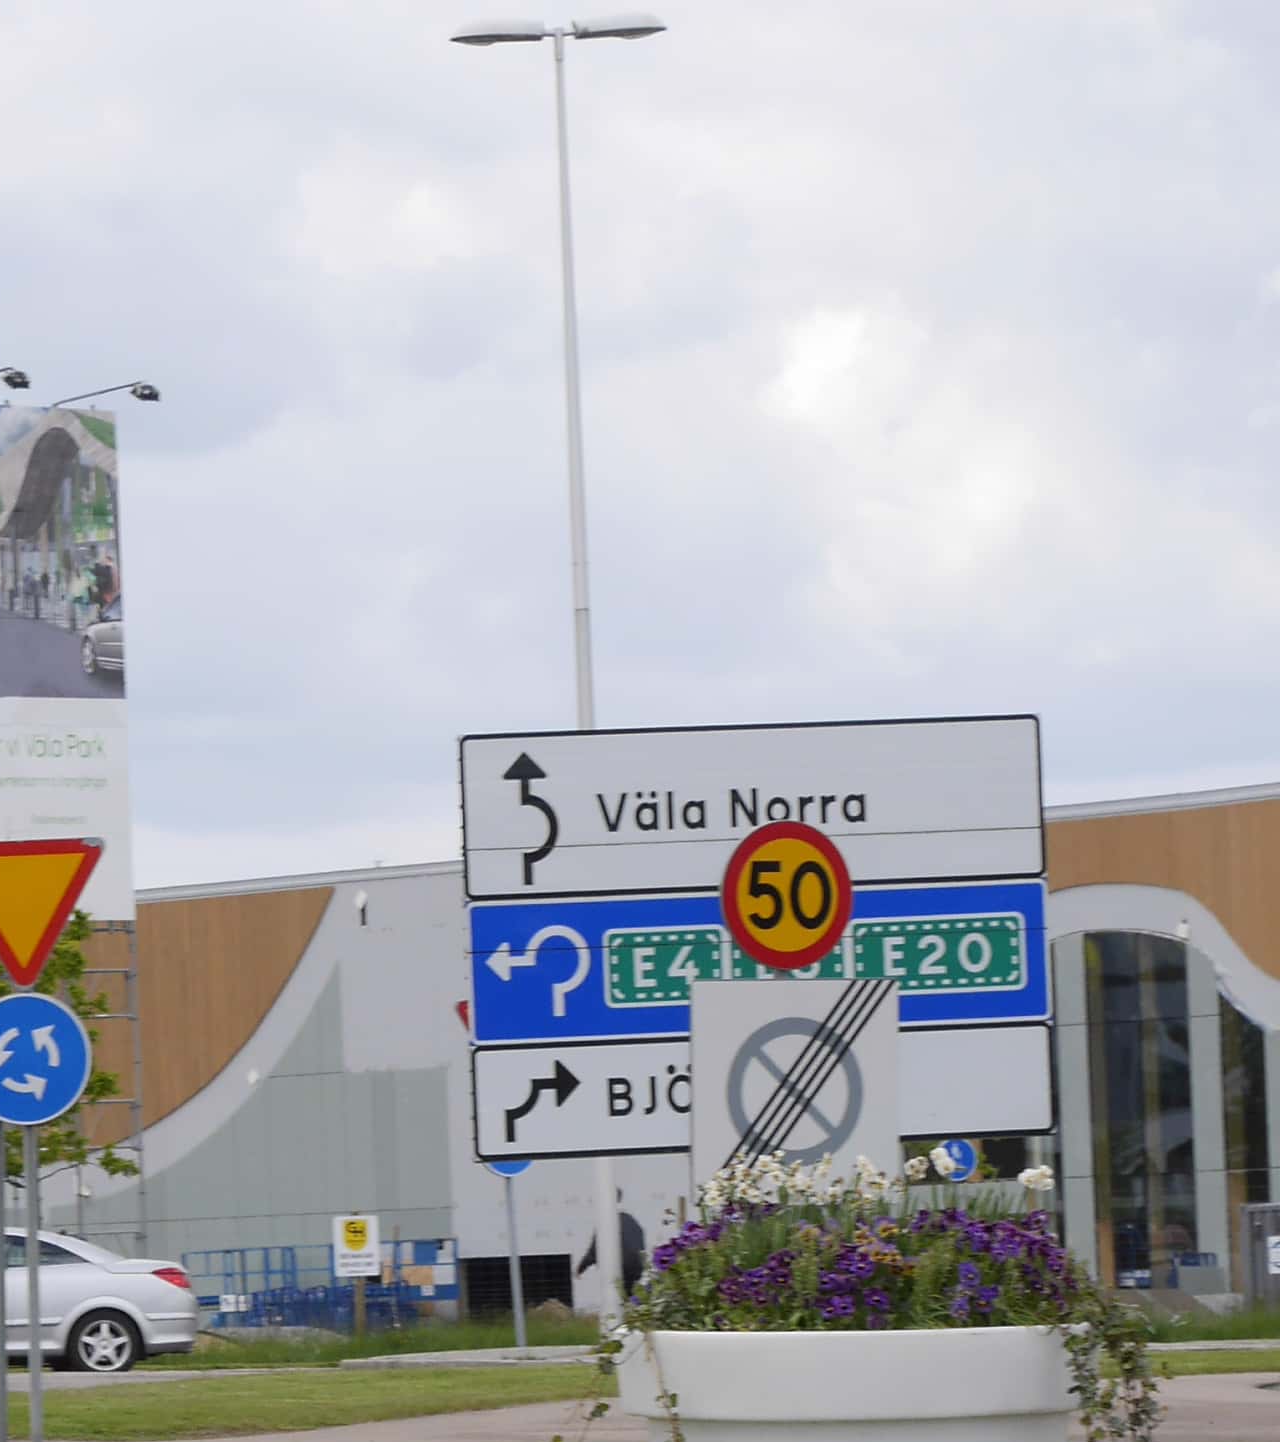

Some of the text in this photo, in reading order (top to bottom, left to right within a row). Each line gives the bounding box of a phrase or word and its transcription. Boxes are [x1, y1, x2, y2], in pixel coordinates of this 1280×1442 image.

[597, 788, 867, 832] Väla Norra
[749, 861, 831, 930] 50
[632, 932, 992, 988] E4 E20
